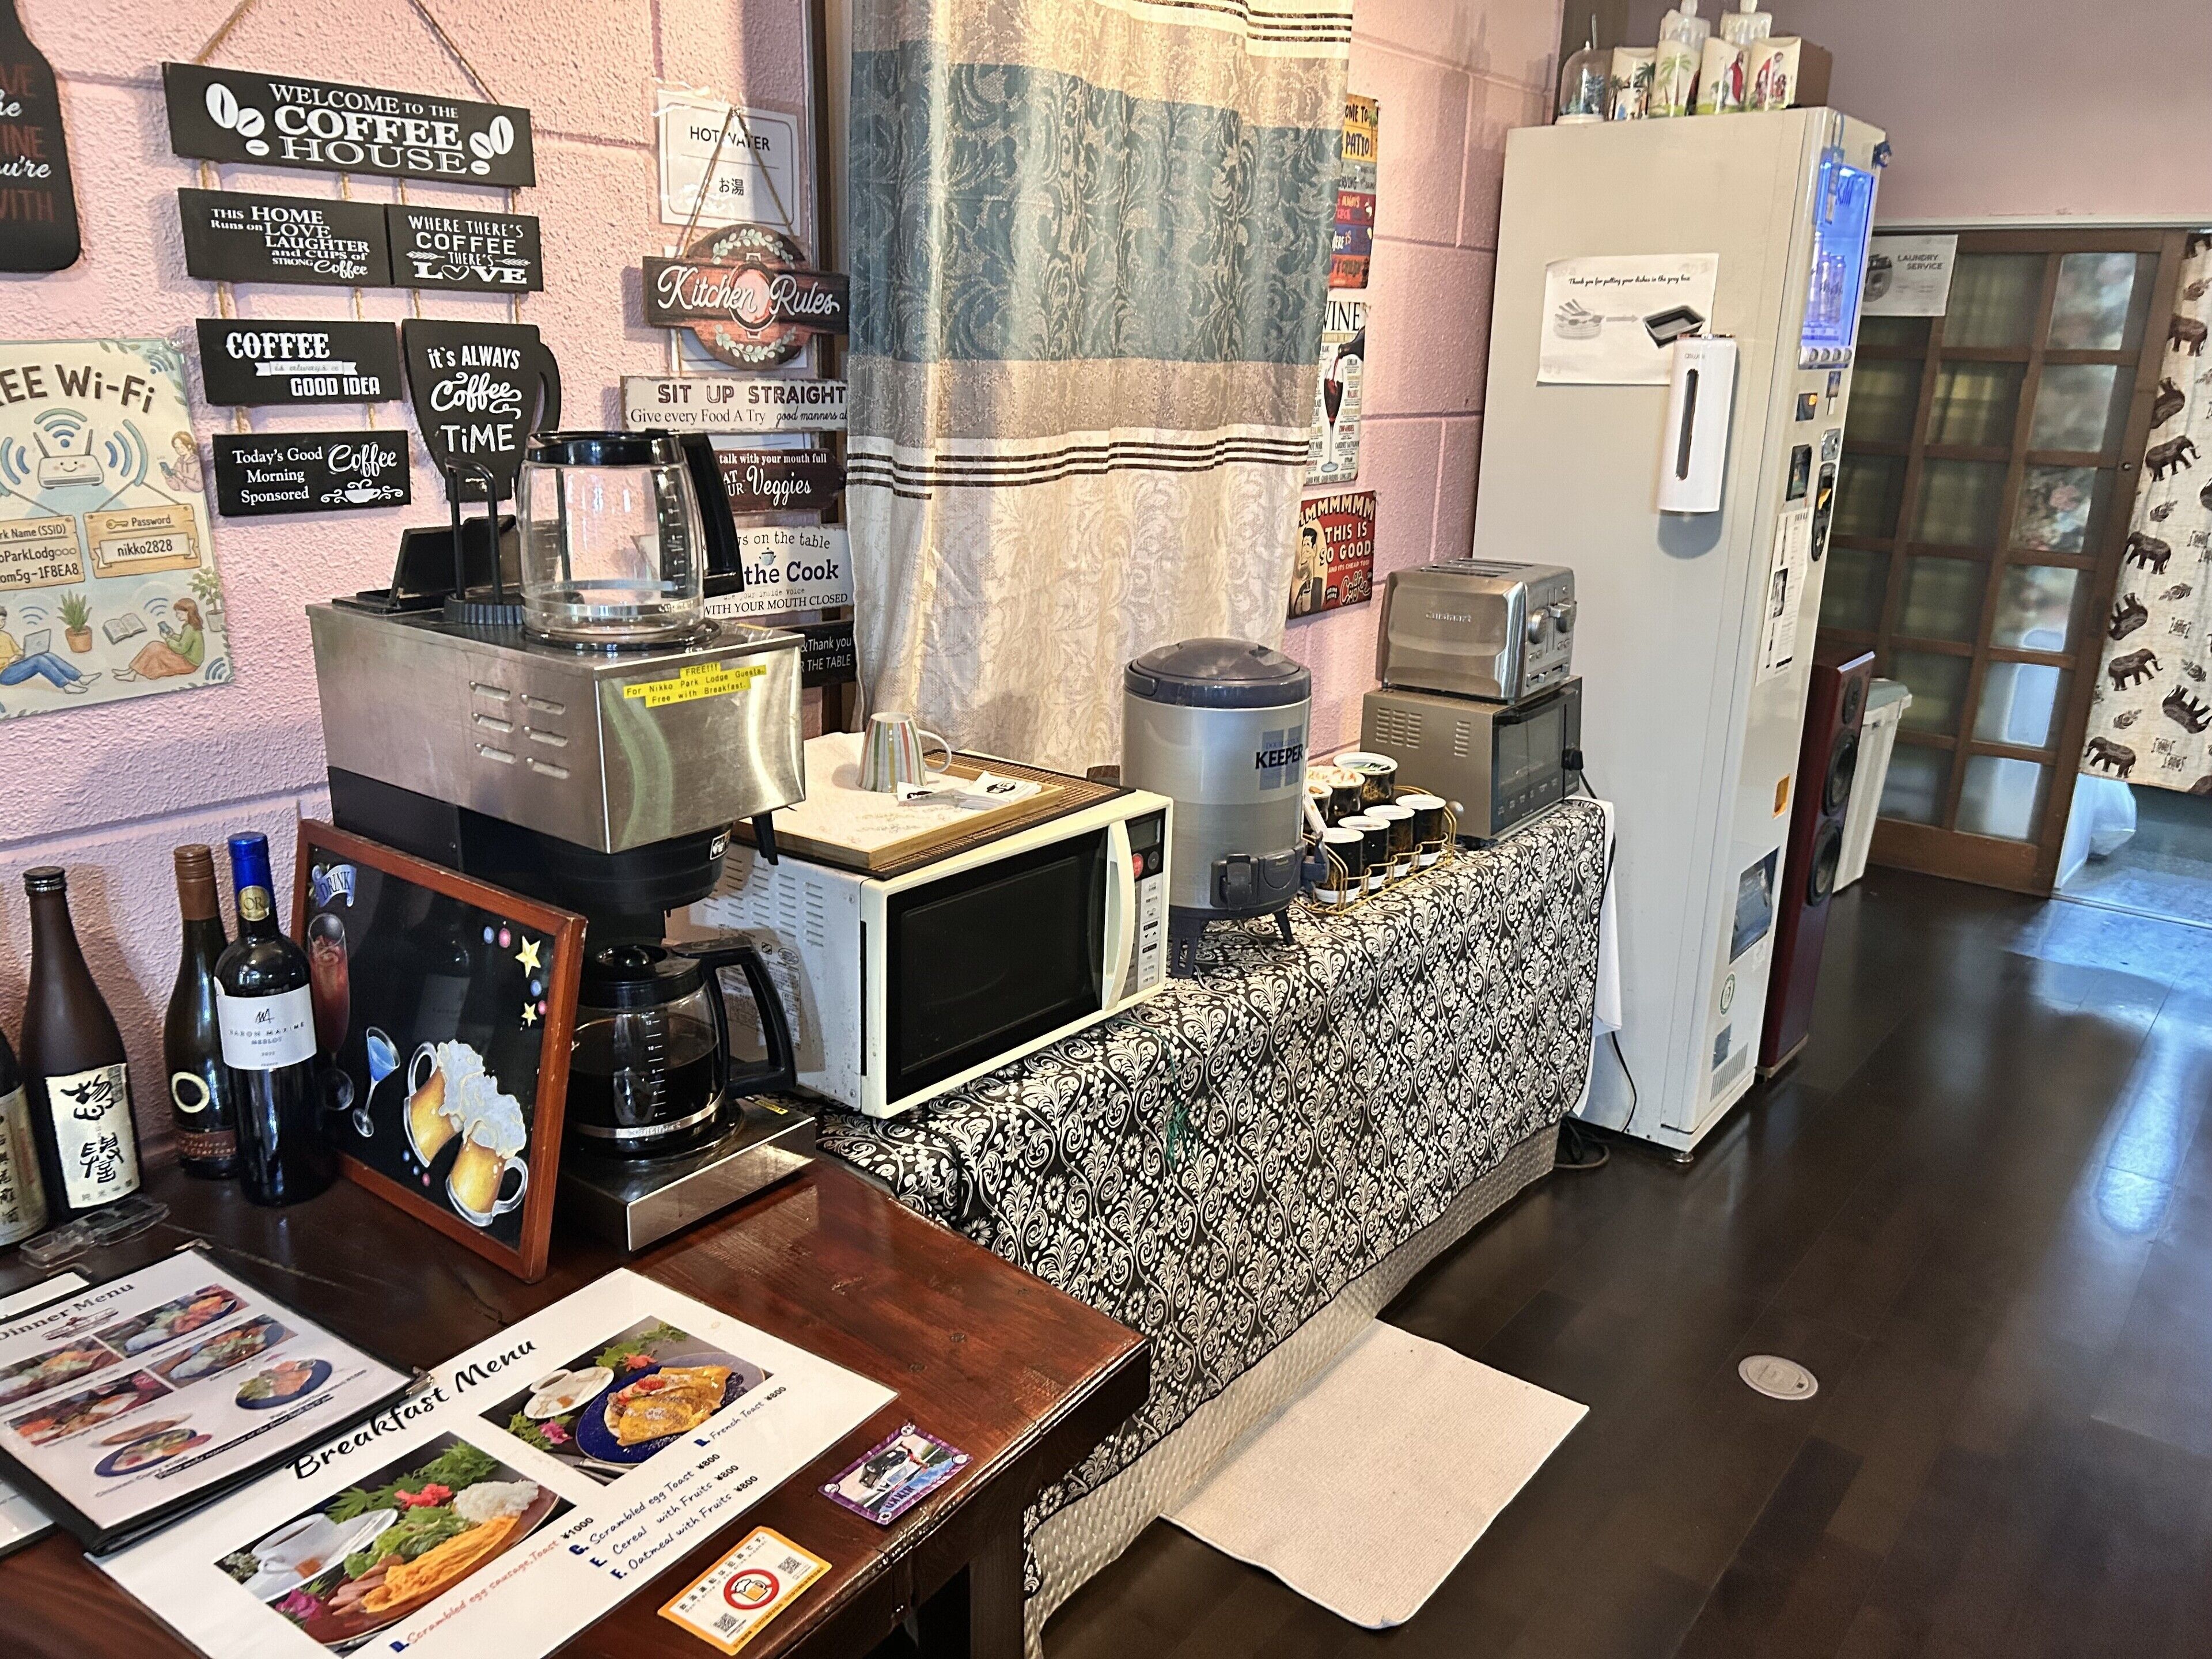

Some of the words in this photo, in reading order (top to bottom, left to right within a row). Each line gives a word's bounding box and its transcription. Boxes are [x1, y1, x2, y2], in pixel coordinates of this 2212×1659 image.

[268, 84, 399, 115] WELCOME
[403, 102, 423, 115] TO
[429, 104, 459, 119] THE
[1361, 105, 1369, 124] TO
[274, 104, 463, 151] COFFEE
[690, 126, 720, 143] HOT
[1345, 130, 1370, 158] PATIO
[279, 136, 467, 174] HOUSE
[718, 178, 745, 196] お湯
[210, 219, 244, 231] Runs
[246, 223, 263, 232] on
[211, 208, 244, 220] THIS
[251, 206, 324, 225] HOME
[263, 222, 331, 240] LOVE
[408, 215, 461, 233] WHERE
[465, 220, 524, 238] THERE'S
[265, 236, 370, 253] LAUGHTER
[271, 248, 301, 257] and
[351, 252, 368, 261] of
[415, 232, 517, 256] COFFEE
[272, 257, 313, 267] STRONG
[313, 260, 368, 279] Coffee
[447, 251, 495, 267] THERE'S
[1897, 254, 1938, 262] LAUNDRY
[1907, 262, 1944, 270] SERVICE
[657, 265, 758, 313] Kitchen
[768, 274, 840, 316] Rules
[1585, 279, 1594, 287] you
[1594, 277, 1603, 286] for
[1603, 277, 1621, 286] putting
[1622, 278, 1634, 286] your
[1635, 275, 1650, 283] dishes
[225, 331, 331, 360] COFFEE
[289, 363, 329, 373] always
[461, 345, 521, 371] ALWAYS
[54, 363, 156, 414] Wi-Fi
[290, 376, 338, 397] GOOD
[342, 376, 381, 396] IDEA
[430, 372, 522, 420] Coffee
[657, 384, 691, 404] SIT
[706, 384, 734, 404] UP
[748, 385, 846, 405] STRAIGHT
[630, 408, 661, 423] Give
[664, 410, 698, 426] every
[701, 408, 730, 423] Food
[733, 409, 743, 422] A
[747, 408, 766, 425] Try
[775, 406, 798, 429] good
[800, 411, 838, 421] manners
[232, 448, 284, 464] Today's
[286, 446, 324, 462] Good
[327, 442, 398, 478] Coffee
[719, 453, 737, 464] talk
[739, 453, 760, 464] with
[761, 456, 781, 467] your
[783, 454, 810, 464] mouth
[812, 453, 827, 463] full
[246, 468, 305, 486] Morning
[746, 465, 812, 506] Veggies
[240, 487, 310, 505] Sponsored
[11, 528, 37, 539] Name
[37, 523, 66, 536] (SSID)
[131, 513, 172, 528] Password
[753, 533, 770, 544] on
[774, 531, 795, 545] the
[800, 532, 831, 550] table
[1325, 524, 1353, 544] THIS
[1357, 521, 1368, 539] IS
[117, 537, 173, 559] nikko2828
[1319, 547, 1334, 566] SO
[744, 563, 780, 586] the
[786, 558, 839, 583] Cook
[786, 587, 805, 596] voice
[1340, 569, 1372, 605] Coffee
[733, 600, 765, 613] YOUR
[767, 596, 808, 610] MOUTH
[809, 592, 849, 605] CLOSED
[835, 637, 852, 652] you
[685, 663, 718, 676] FREE!!!
[807, 658, 824, 672] THE
[825, 653, 851, 669] TABLE
[626, 687, 642, 696] For
[649, 683, 673, 693] Nikko
[680, 679, 699, 689] Park
[705, 675, 729, 684] Lodge
[652, 695, 672, 704] Free
[677, 690, 698, 700] with
[704, 683, 747, 695] Breakfast.
[1255, 743, 1304, 770] KEEPER
[319, 871, 350, 900] DRINK
[266, 1021, 305, 1036] MAXIME
[72, 1283, 135, 1312] Menu
[285, 1385, 450, 1480] Breakfast
[453, 1339, 537, 1394] Menu
[709, 1416, 742, 1441] French
[740, 1400, 765, 1419] Toast
[764, 1385, 787, 1402] ¥800
[589, 1502, 647, 1546] Scrambled
[648, 1490, 667, 1506] egg
[664, 1470, 695, 1493] Toast
[696, 1453, 721, 1471] ¥800
[612, 1525, 647, 1555] Cereal
[656, 1506, 681, 1524] with
[680, 1481, 713, 1508] Fruits
[714, 1464, 739, 1483] ¥800
[627, 1531, 675, 1571] Oatmeal
[675, 1518, 700, 1537] with
[699, 1492, 734, 1519] Fruits
[733, 1475, 759, 1494] ¥800
[406, 1599, 467, 1645] Scrambled
[468, 1587, 489, 1603] egg
[528, 1540, 560, 1564] Toast
[559, 1516, 595, 1540] ¥1000
